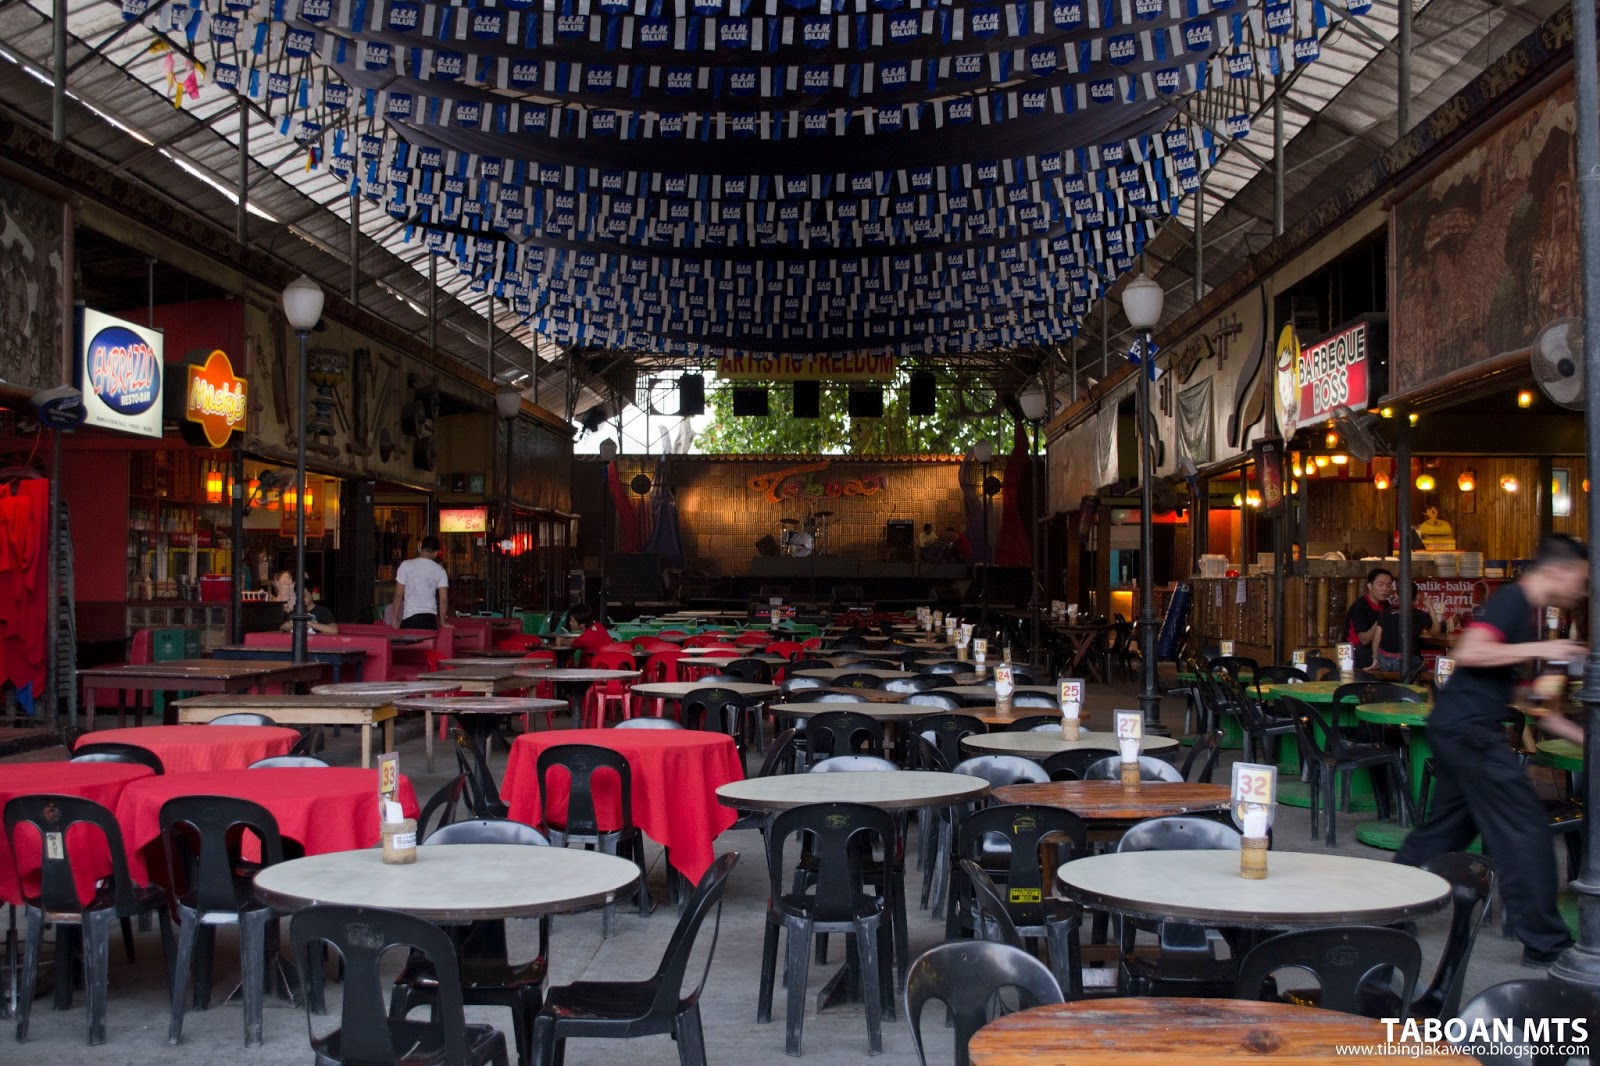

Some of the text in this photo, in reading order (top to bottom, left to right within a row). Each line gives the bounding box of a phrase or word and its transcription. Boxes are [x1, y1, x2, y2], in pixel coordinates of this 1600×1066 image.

[304, 7, 329, 17] BLUE
[1137, 4, 1163, 13] BLUE
[391, 16, 416, 26] BLUE
[1055, 14, 1079, 24] BLUE
[475, 23, 499, 34] BLUE
[558, 23, 584, 32] BLUE
[973, 22, 998, 31] BLUE
[641, 33, 668, 41] BLUE
[721, 32, 747, 40] BLUE
[805, 32, 830, 40] BLUE
[891, 28, 916, 37] BLUE
[1188, 33, 1211, 45] BLUE
[289, 40, 311, 53] BLUE
[1111, 47, 1134, 59] BLUE
[1296, 48, 1317, 58] BLUE
[1032, 59, 1055, 69] BLUE
[438, 64, 460, 75] BLUE
[217, 74, 236, 85] BLUE
[514, 72, 537, 82] BLUE
[588, 78, 612, 86] BLUE
[883, 74, 906, 84] BLUE
[805, 78, 828, 87] BLUE
[1157, 79, 1179, 87] BLUE
[270, 84, 287, 95] BLUE
[325, 95, 345, 105] BLUE
[390, 105, 409, 114] BLUE
[950, 110, 971, 118] BLUE
[457, 113, 478, 121] BLUE
[660, 124, 681, 132] BLUE
[1167, 139, 1186, 149] BLUE
[1104, 152, 1122, 161] BLUE
[421, 158, 439, 167] BLUE
[481, 168, 499, 176] BLUE
[978, 172, 997, 180] BLUE
[540, 175, 559, 183] BLUE
[603, 181, 621, 189] BLUE
[1298, 325, 1366, 388] BARBEQUE
[94, 343, 155, 398] EMBRAZZO
[1312, 369, 1348, 415] BOSS
[975, 641, 985, 649] 18
[1338, 646, 1350, 656] 22
[1439, 660, 1454, 672] 23
[998, 671, 1010, 681] 24
[1063, 685, 1079, 697] 25
[1119, 718, 1139, 732] 27
[383, 766, 396, 787] 33
[1240, 774, 1267, 797] 32
